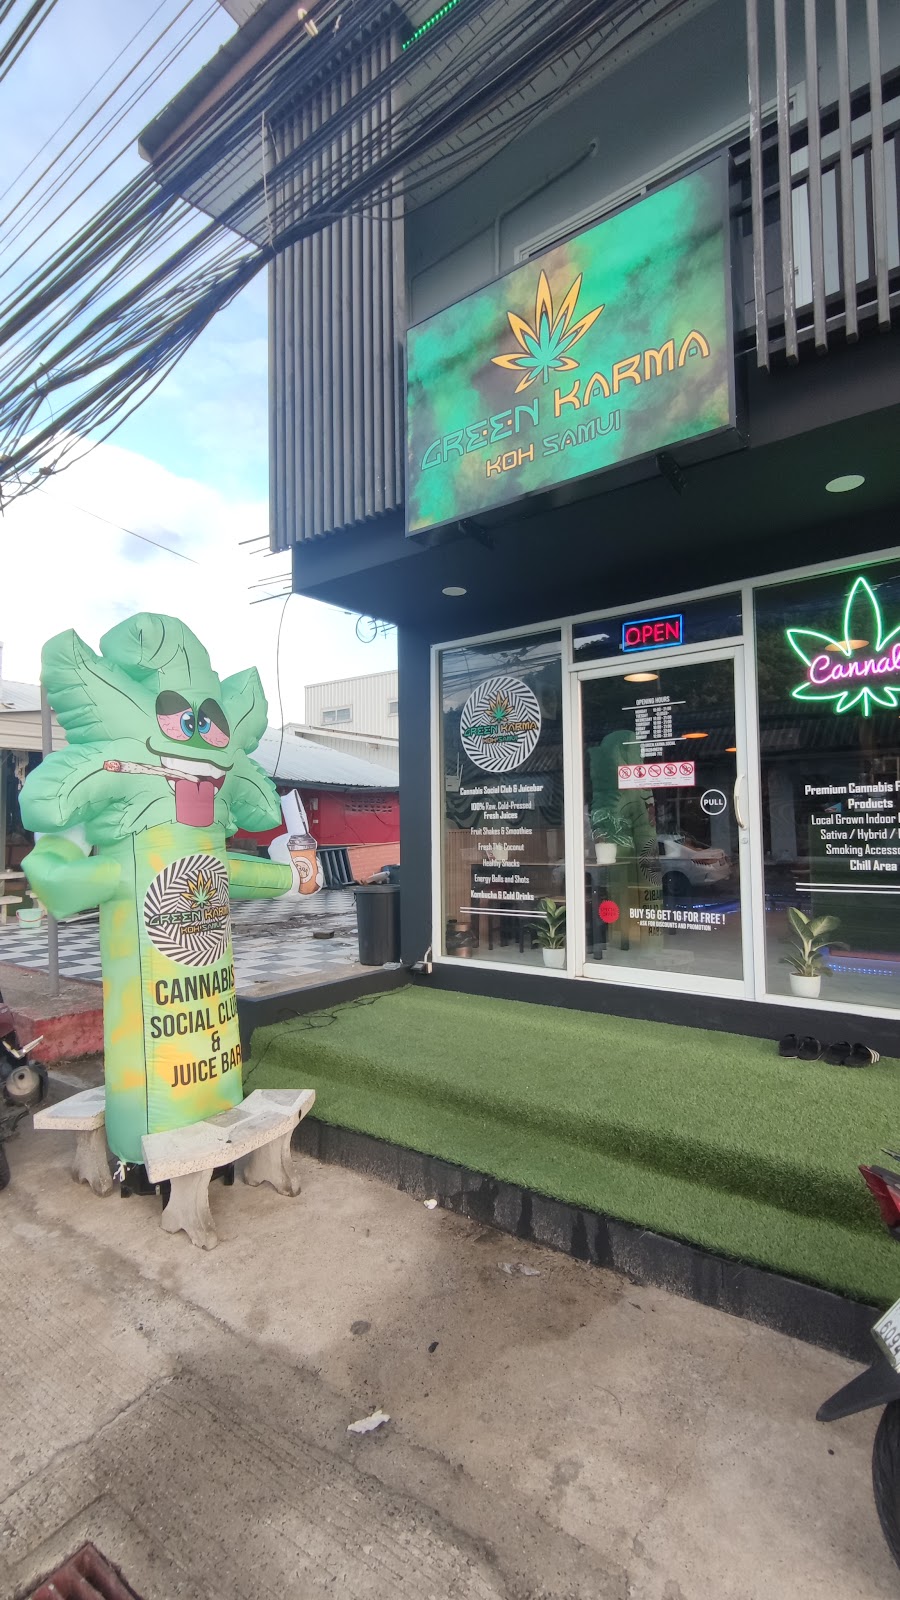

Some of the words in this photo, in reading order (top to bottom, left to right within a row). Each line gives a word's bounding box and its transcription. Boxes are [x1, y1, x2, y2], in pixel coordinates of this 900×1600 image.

[421, 398, 539, 470] GREEN
[554, 329, 711, 417] KARMA
[486, 444, 534, 478] KOH
[543, 409, 621, 456] SAMUI
[626, 621, 679, 645] OPEN
[464, 725, 499, 737] GREEN
[500, 721, 539, 732] KARMA
[460, 787, 483, 795] Cannabis
[484, 786, 499, 794] Social
[500, 785, 512, 793] Club
[518, 784, 543, 793] Juicebar
[804, 785, 847, 795] Premium
[848, 781, 893, 793] Cannabis
[471, 802, 485, 810] 100%
[848, 798, 893, 809] Products
[484, 811, 499, 819] Fresh
[500, 811, 518, 819] Juices
[811, 814, 834, 825] Local
[835, 813, 864, 825] Grown
[866, 813, 896, 824] Indoor
[471, 827, 482, 835] Fruit
[483, 827, 500, 835] Shakes
[506, 826, 532, 835] Smoothies
[820, 829, 847, 840] Sativa
[849, 828, 855, 839] /
[857, 828, 887, 841] Hybrid
[889, 828, 896, 839] /
[478, 843, 492, 851] Fresh
[504, 843, 525, 851] Coconut
[826, 844, 863, 857] Smoking
[502, 859, 520, 867] Snacks
[850, 860, 871, 871] Chill
[873, 860, 897, 871] Area
[474, 874, 491, 884] Energy
[516, 892, 534, 900] Drinks
[150, 911, 201, 925] GREEN
[630, 908, 644, 918] BUY
[646, 909, 656, 919] 5G
[657, 909, 671, 920] GET
[673, 910, 681, 920] 1G
[683, 911, 699, 922] FOR
[700, 912, 721, 924] FREE
[181, 926, 200, 934] KOH
[155, 964, 234, 1006] CANNABIS
[150, 1008, 215, 1038] SOCIAL
[211, 1030, 220, 1052] &
[171, 1057, 217, 1087] JUICE
[221, 1044, 242, 1074] BAR
